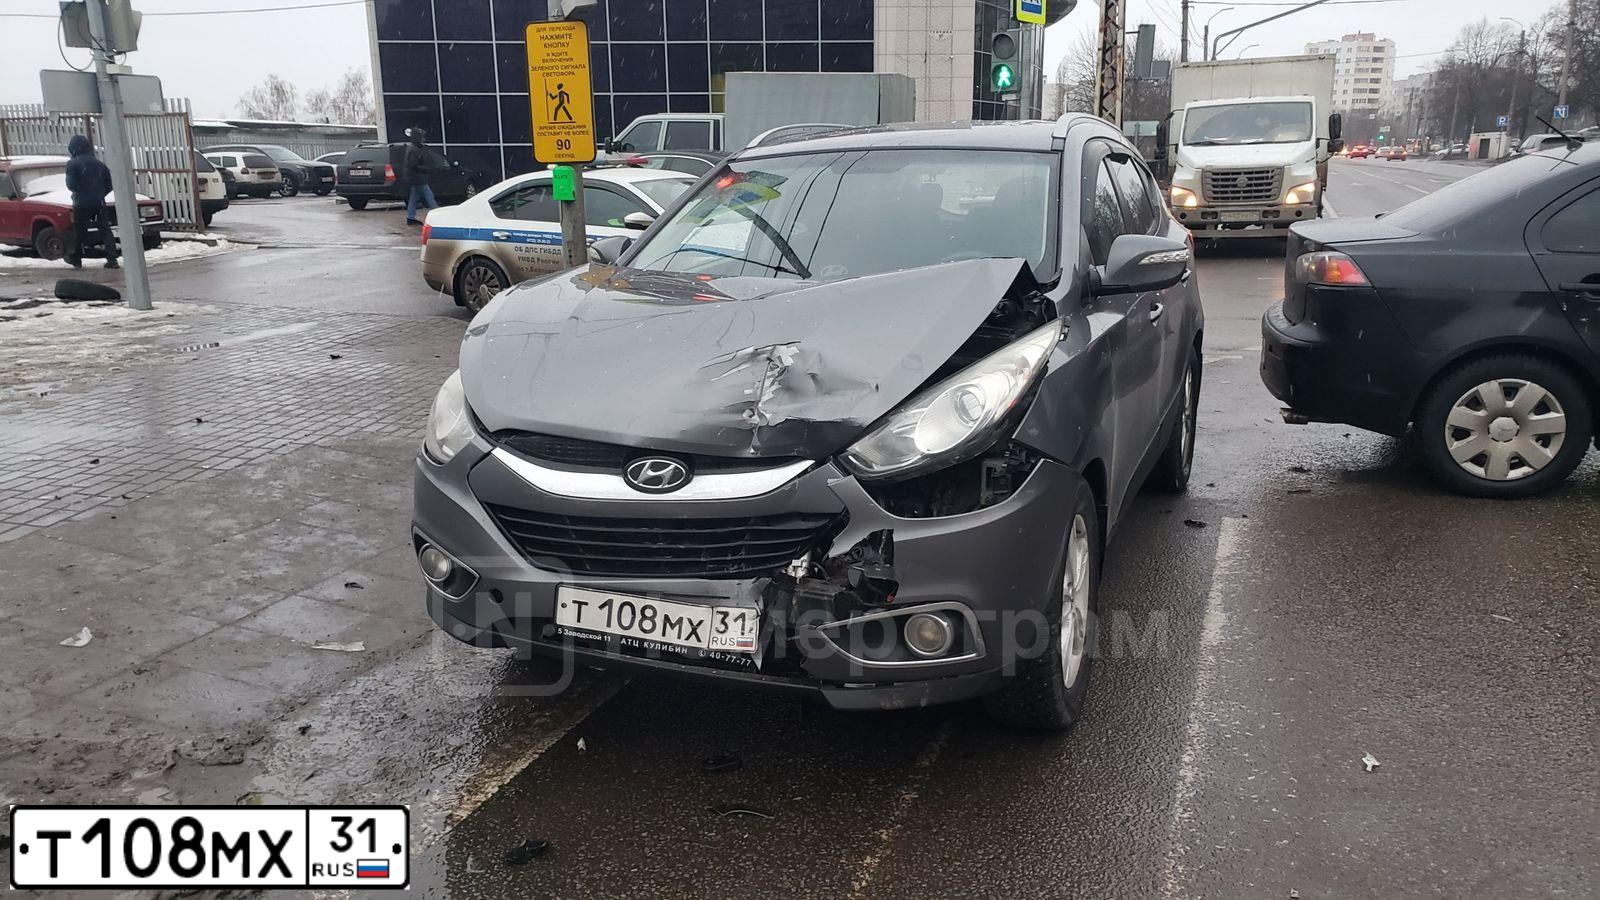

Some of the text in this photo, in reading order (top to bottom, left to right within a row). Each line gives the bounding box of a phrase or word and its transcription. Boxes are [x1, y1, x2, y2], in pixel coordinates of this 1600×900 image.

[556, 139, 571, 150] 90
[540, 247, 561, 255] ГИБДД
[518, 256, 535, 264] УМВД
[715, 610, 747, 636] 31
[563, 629, 602, 641] Заводской
[620, 637, 688, 654] АТЦ КУЛИБИН
[711, 636, 736, 647] RUS
[710, 651, 752, 667] 40-77-77
